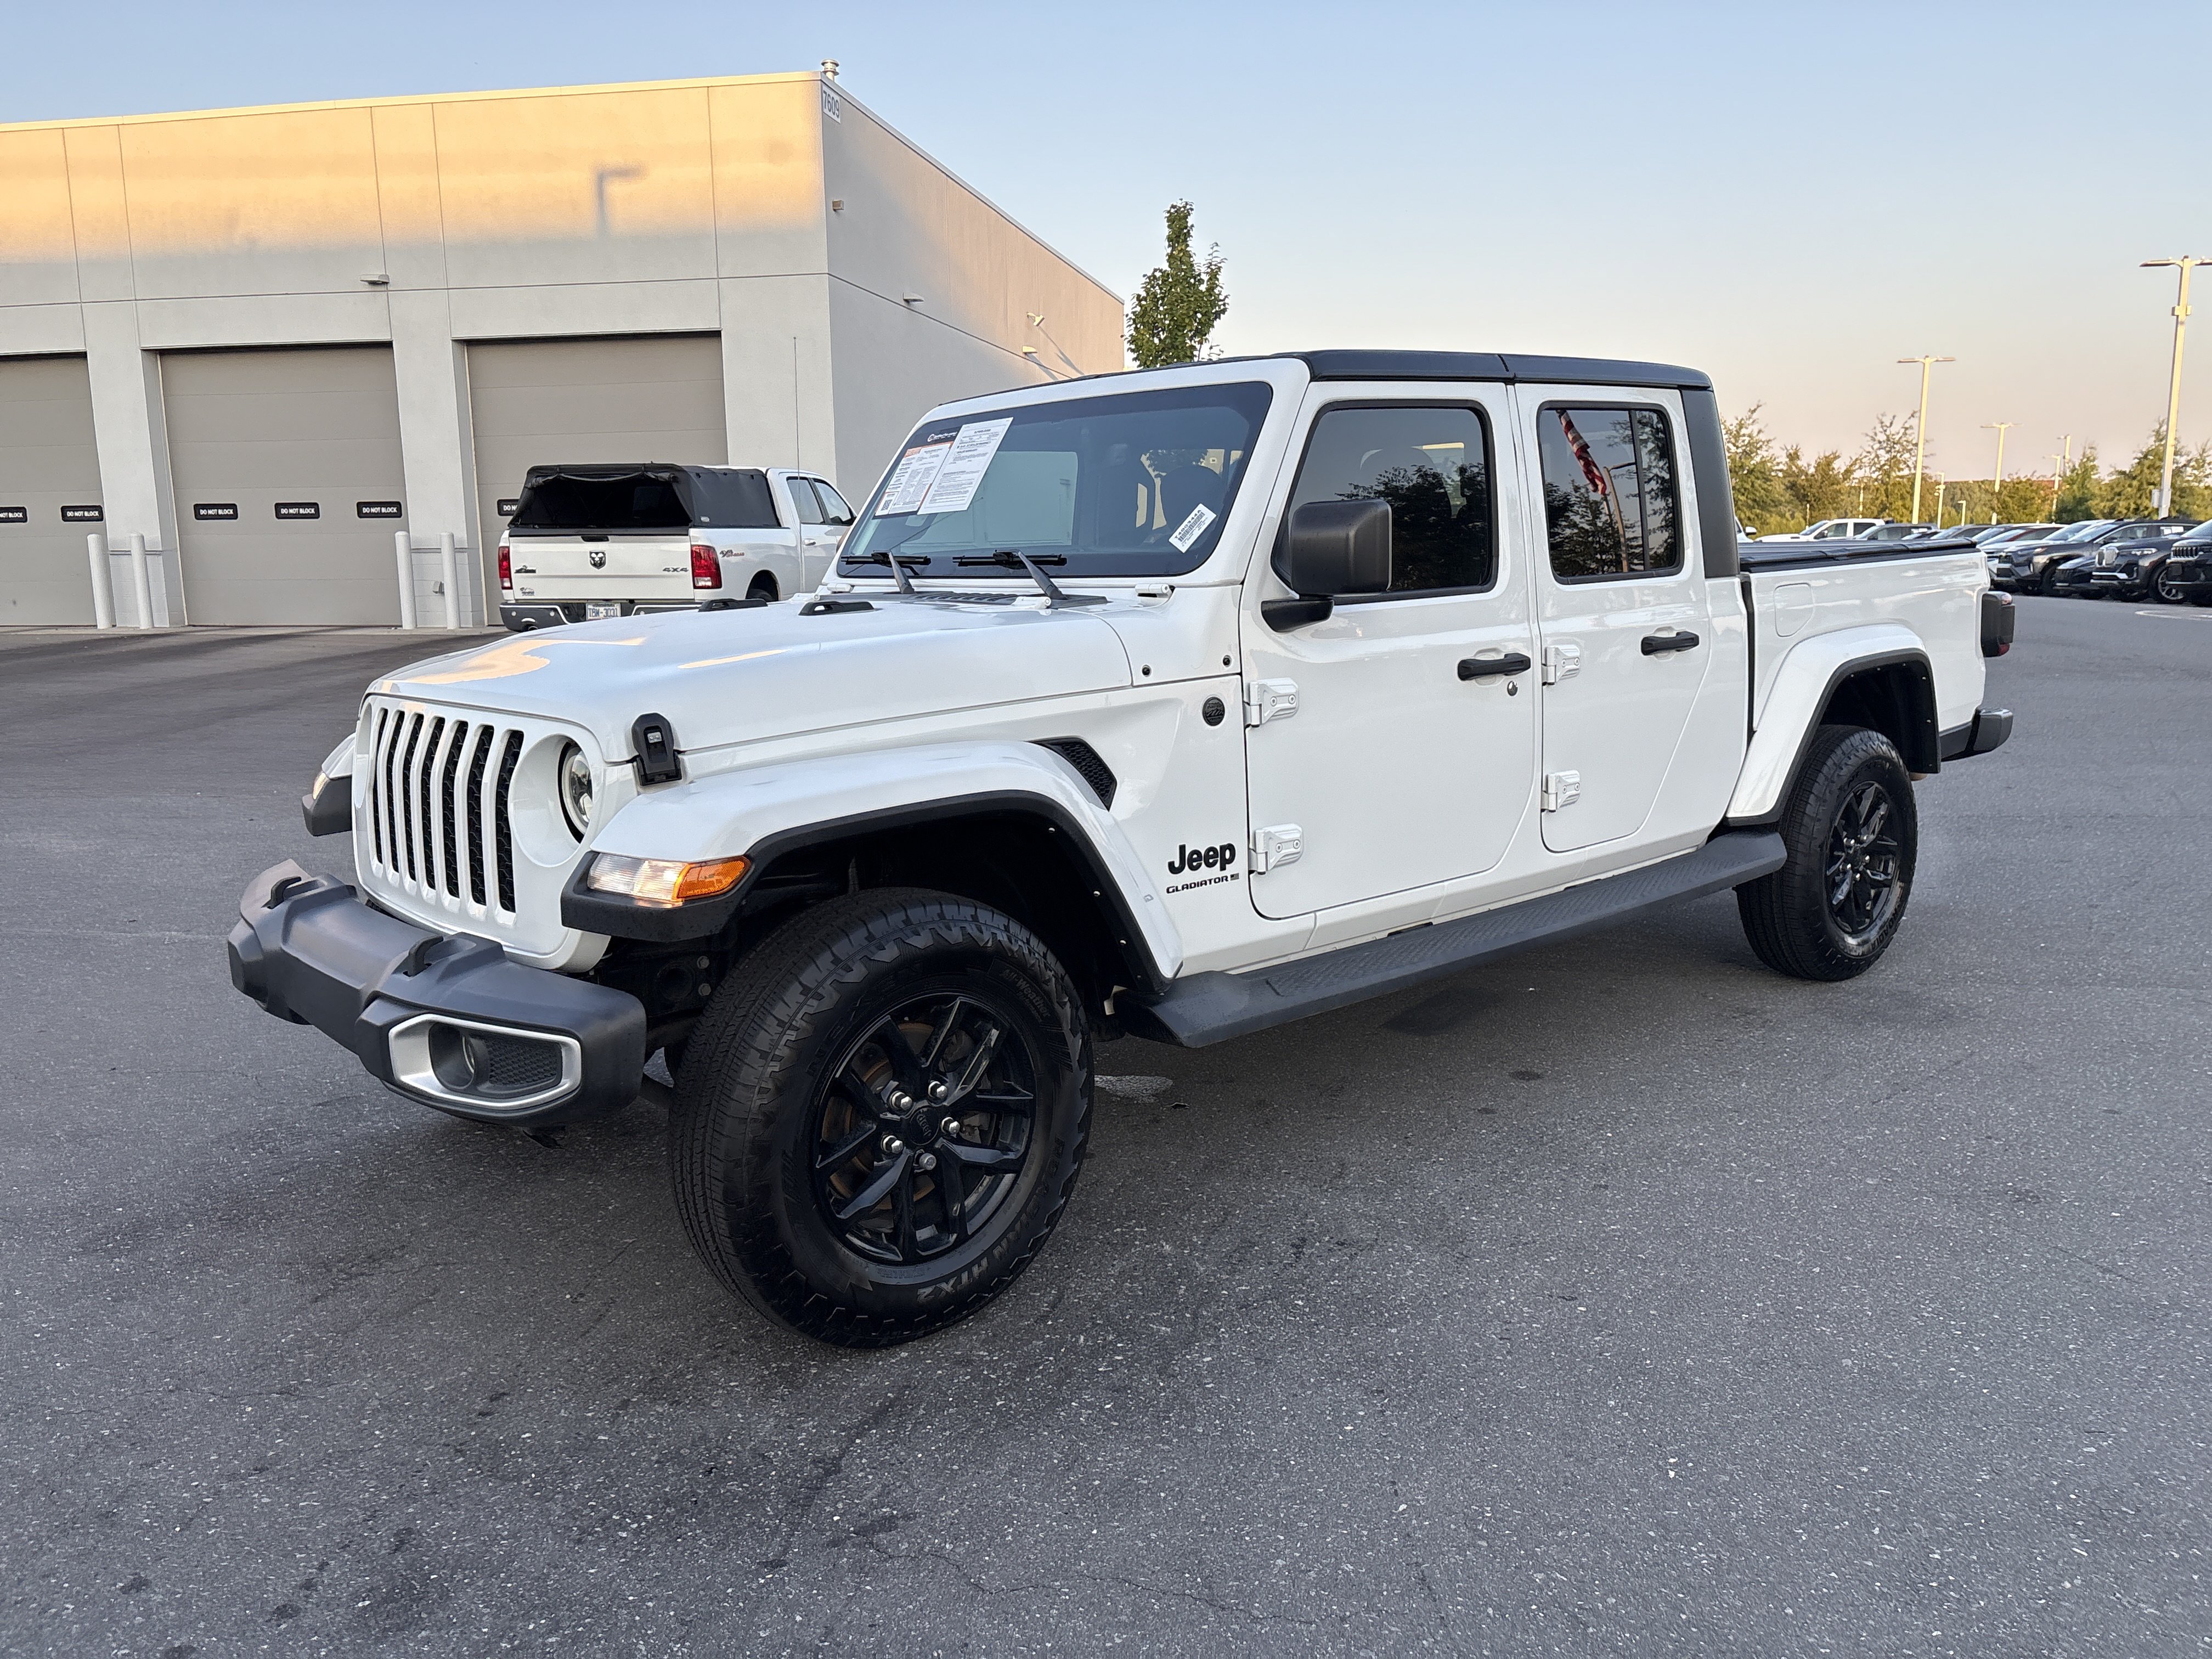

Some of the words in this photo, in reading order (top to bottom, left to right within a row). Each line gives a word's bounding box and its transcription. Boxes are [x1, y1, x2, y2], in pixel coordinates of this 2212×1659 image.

[823, 90, 839, 119] 7609
[1167, 843, 1236, 874] Jeep
[1166, 875, 1229, 894] GLADIATOR
[917, 1254, 991, 1306] HTX2
